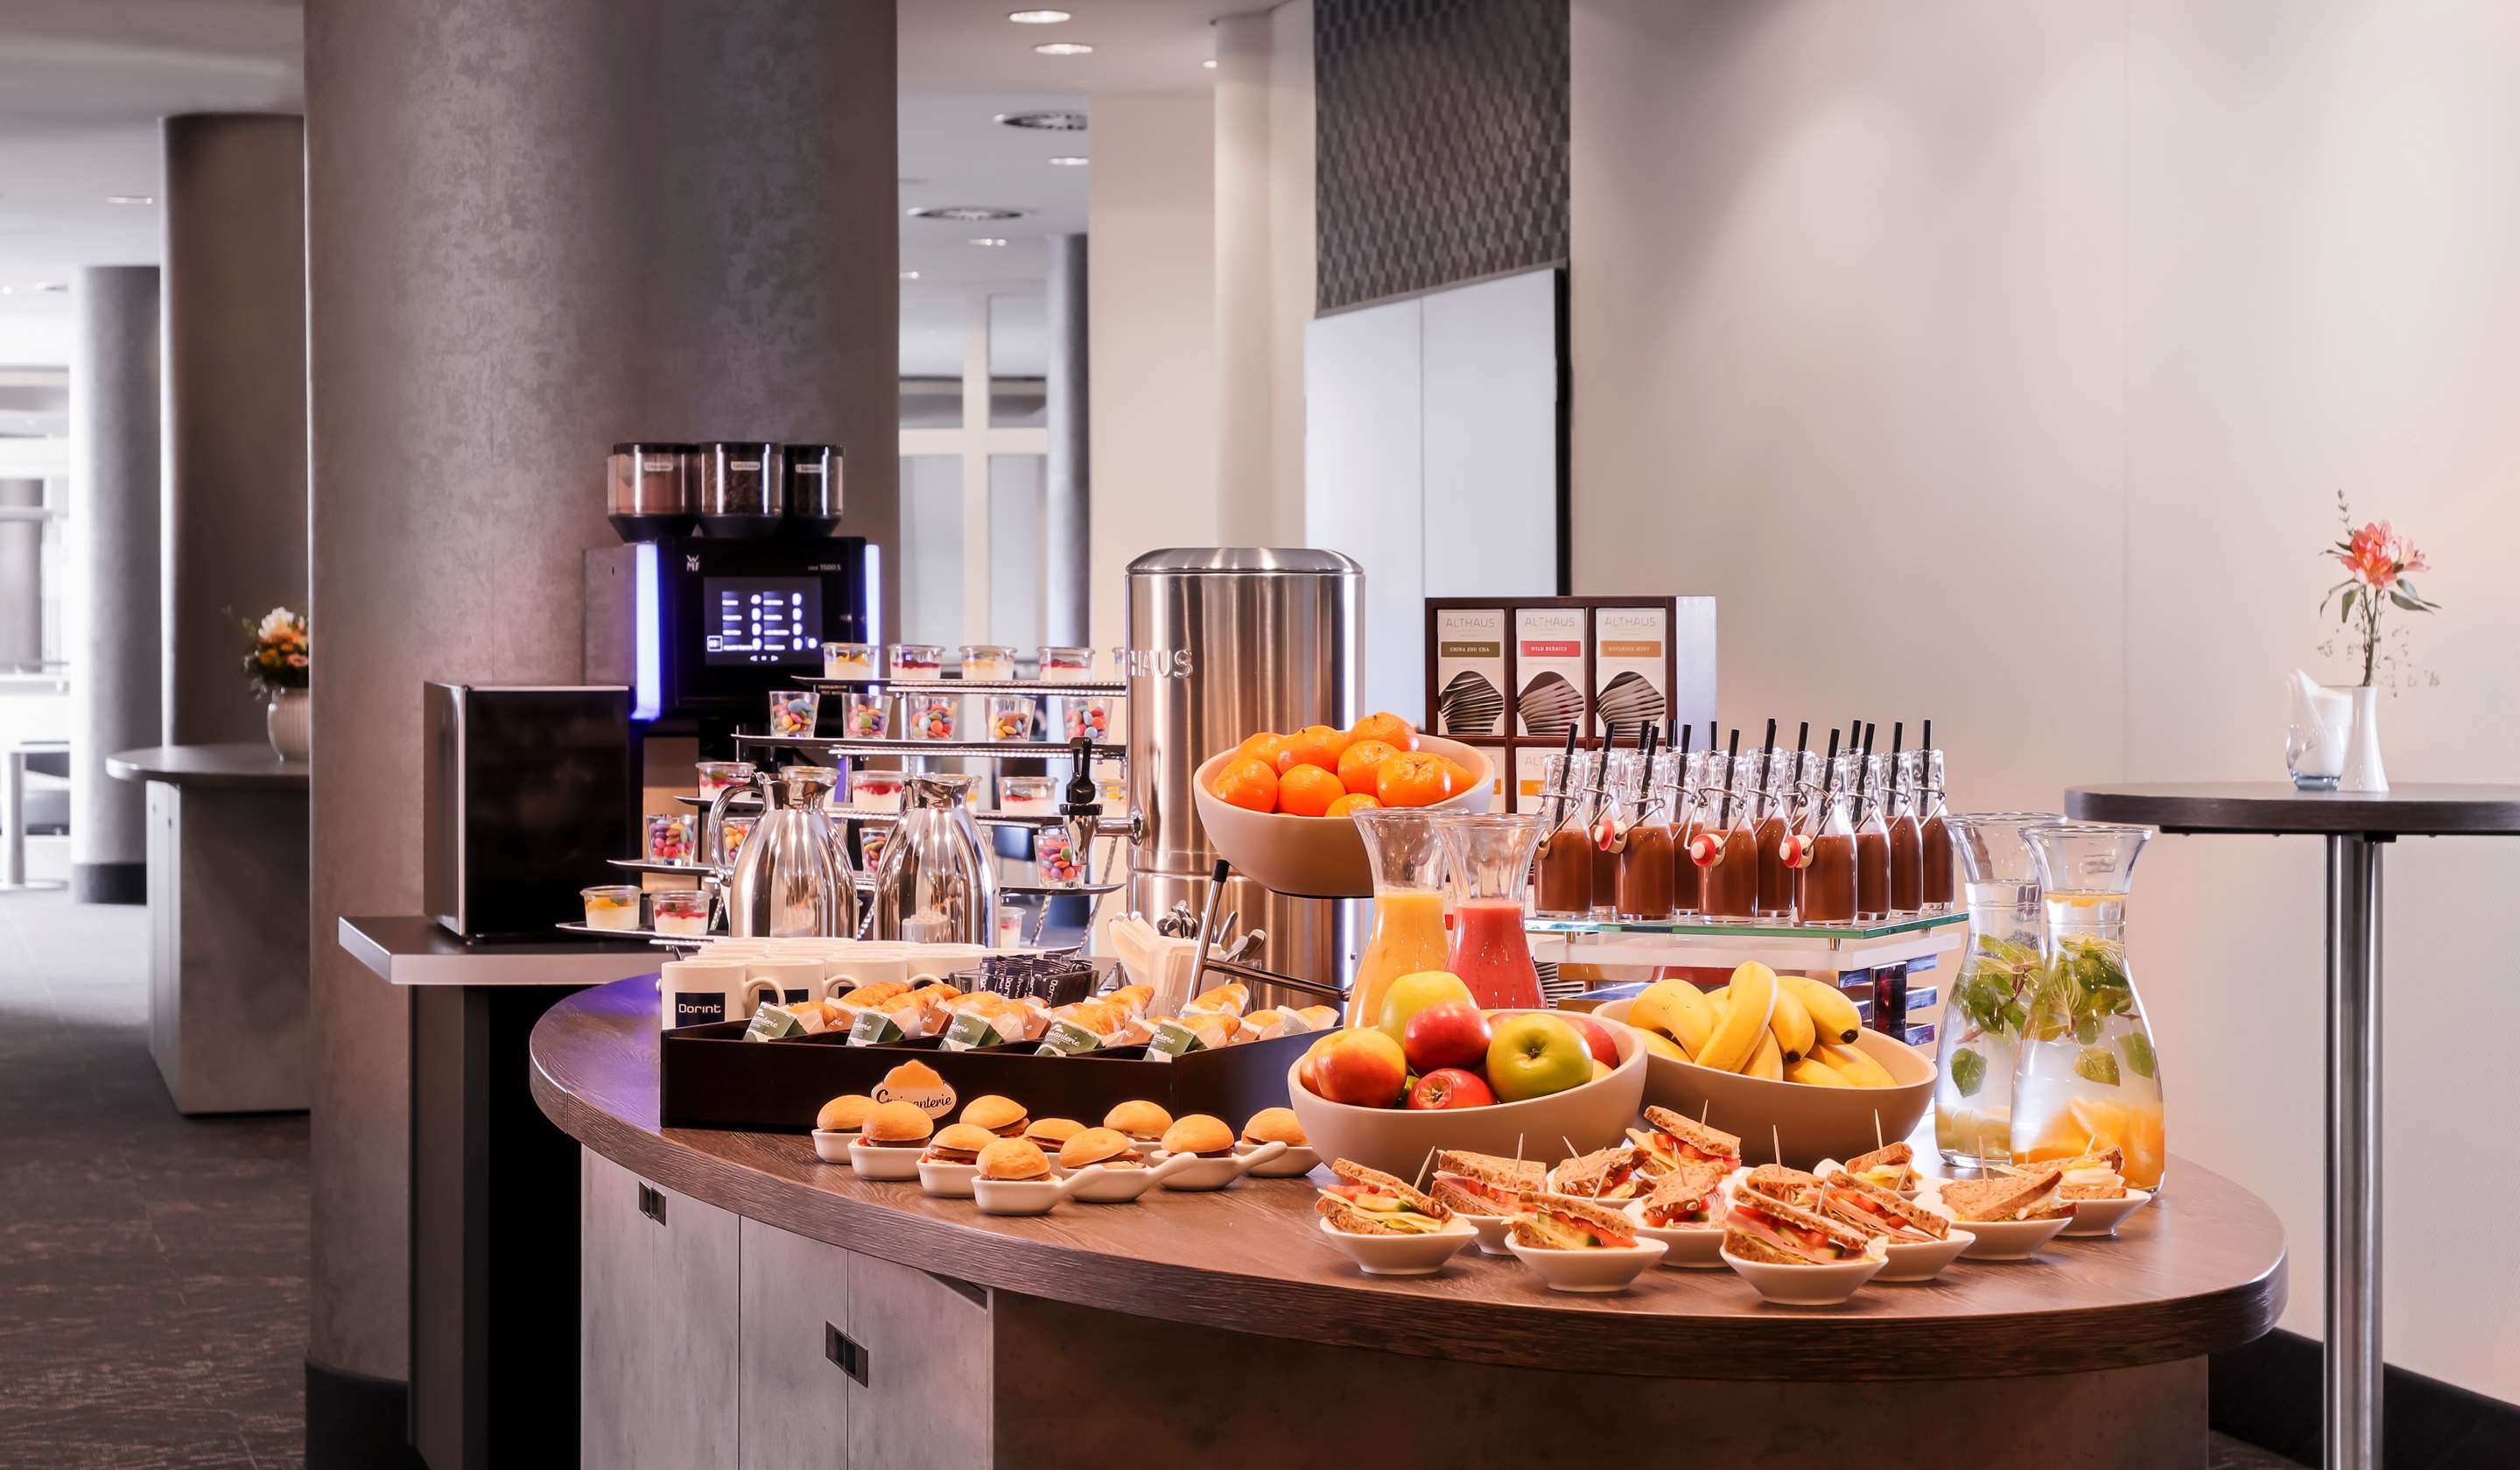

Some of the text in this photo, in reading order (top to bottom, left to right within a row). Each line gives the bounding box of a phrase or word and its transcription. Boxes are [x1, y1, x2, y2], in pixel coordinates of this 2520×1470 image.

[1446, 617, 1495, 629] ALTHAUS
[1525, 616, 1576, 628] ALTHAUS
[1604, 616, 1656, 628] ALTHAUS
[1130, 649, 1193, 678] HAUS
[678, 1003, 721, 1014] Dorint
[876, 1088, 952, 1108] Canterie
